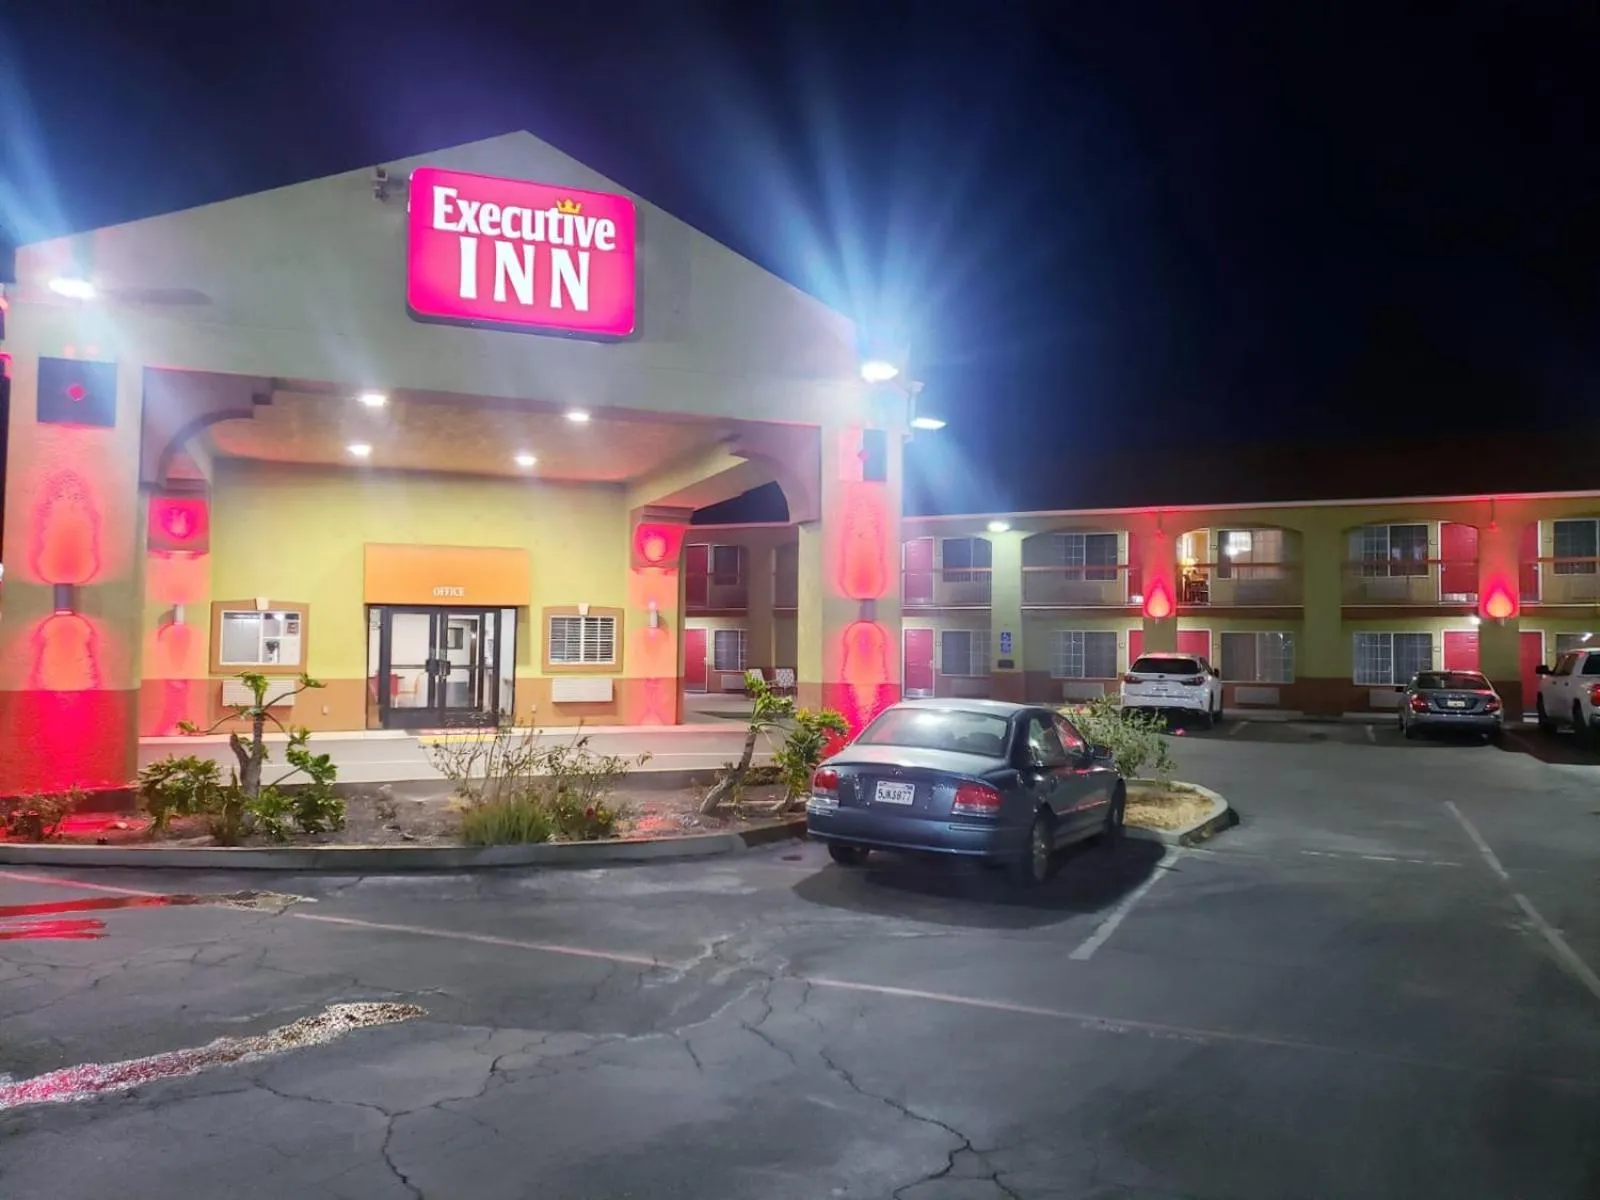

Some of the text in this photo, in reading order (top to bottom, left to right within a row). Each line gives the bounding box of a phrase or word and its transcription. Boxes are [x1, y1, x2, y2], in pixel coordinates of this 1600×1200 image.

[433, 185, 616, 251] Executive
[459, 236, 590, 312] INN
[432, 586, 465, 597] OFFICE
